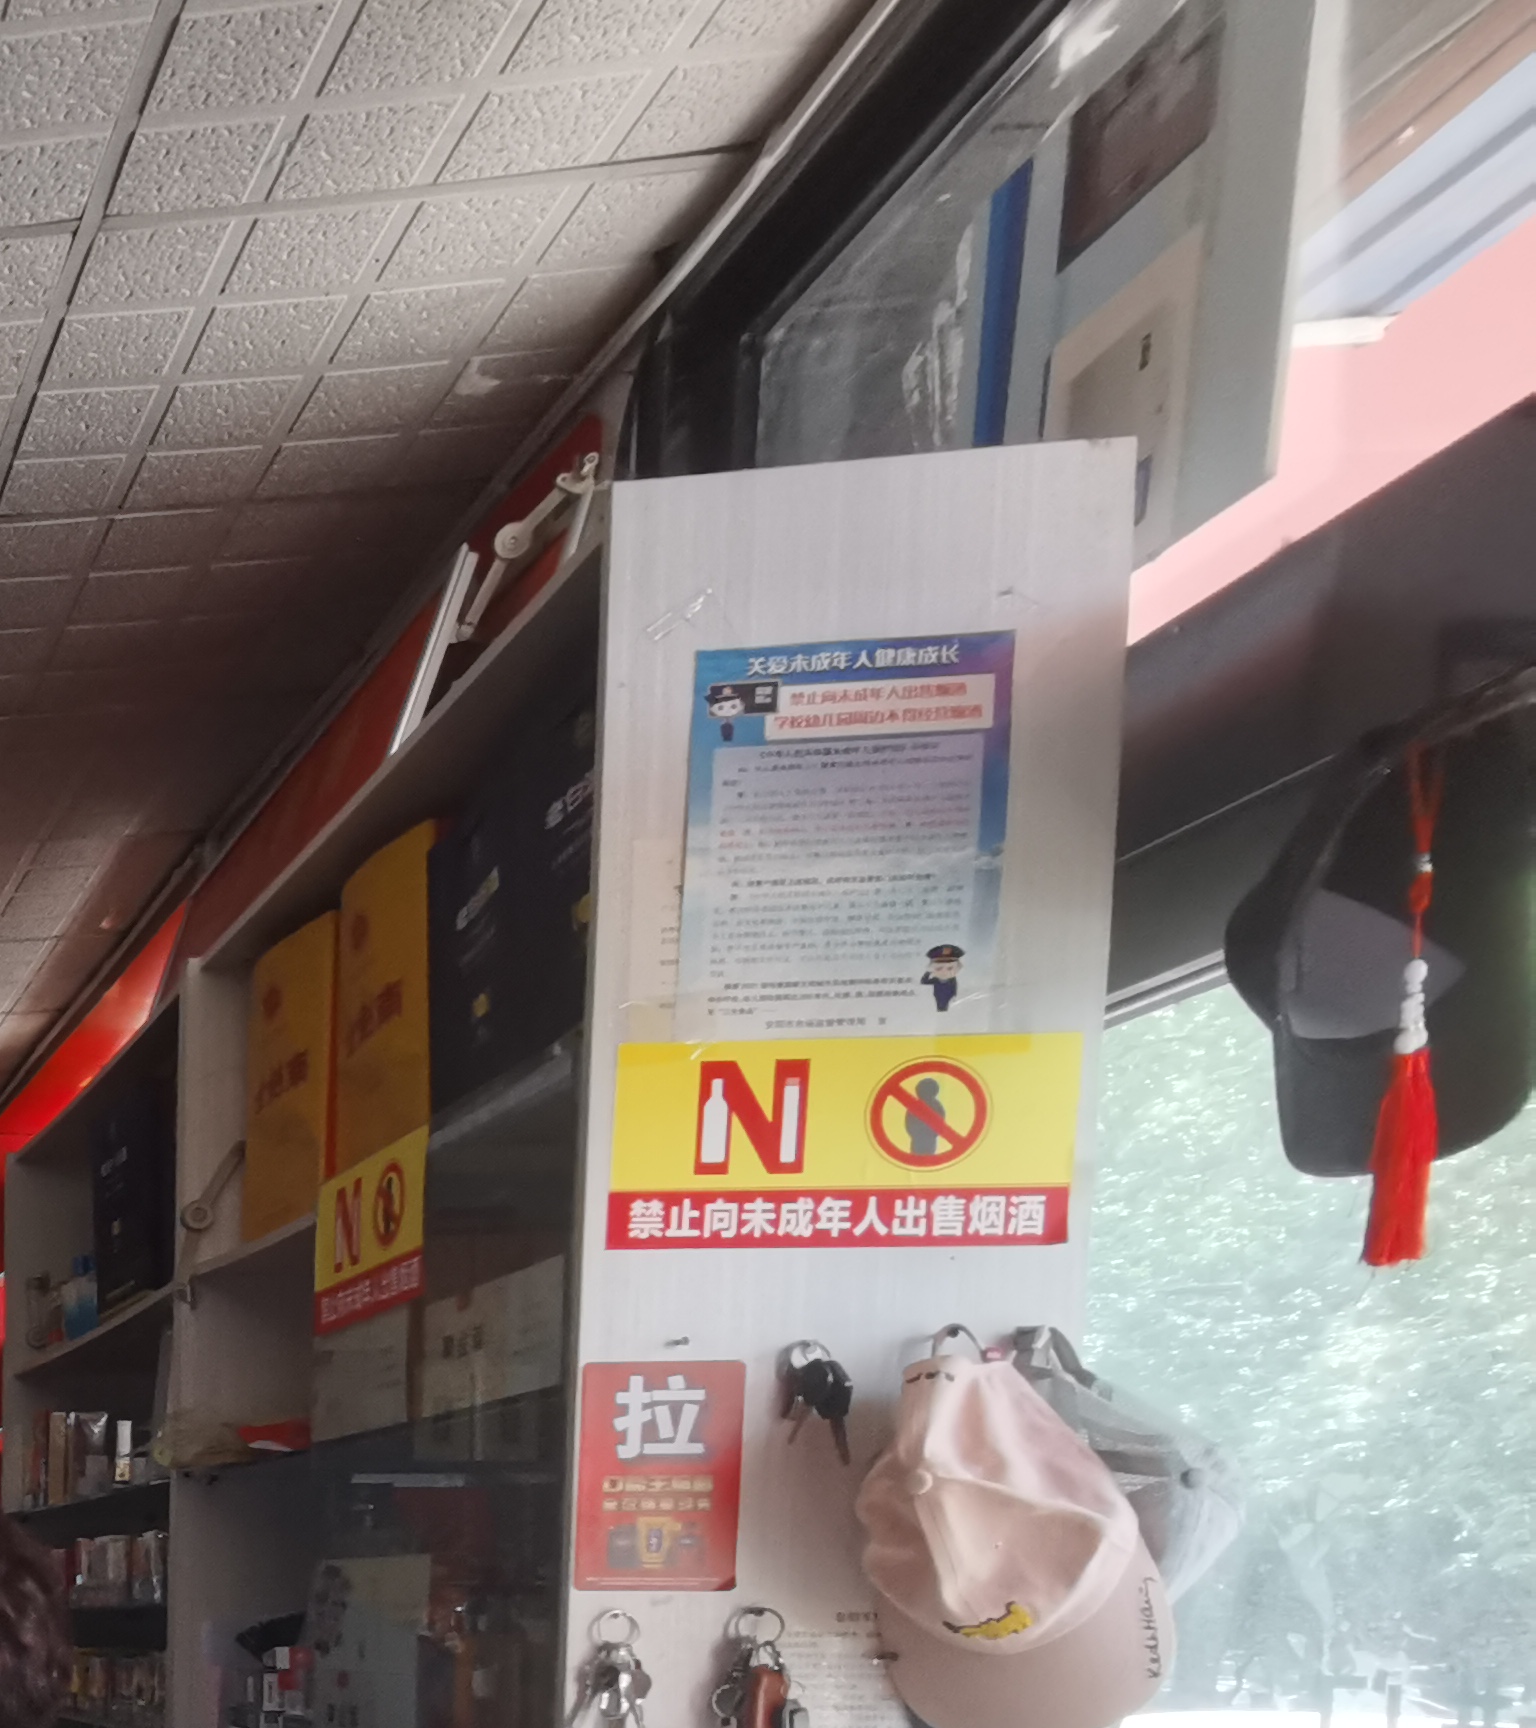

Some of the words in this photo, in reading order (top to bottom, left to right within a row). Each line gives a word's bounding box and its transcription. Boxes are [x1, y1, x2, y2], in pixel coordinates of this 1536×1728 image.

[747, 645, 960, 676] 关爱未成年人健康成长
[628, 1194, 1047, 1241] 禁止向未成年人出售烟酒
[613, 1374, 706, 1459] 拉
